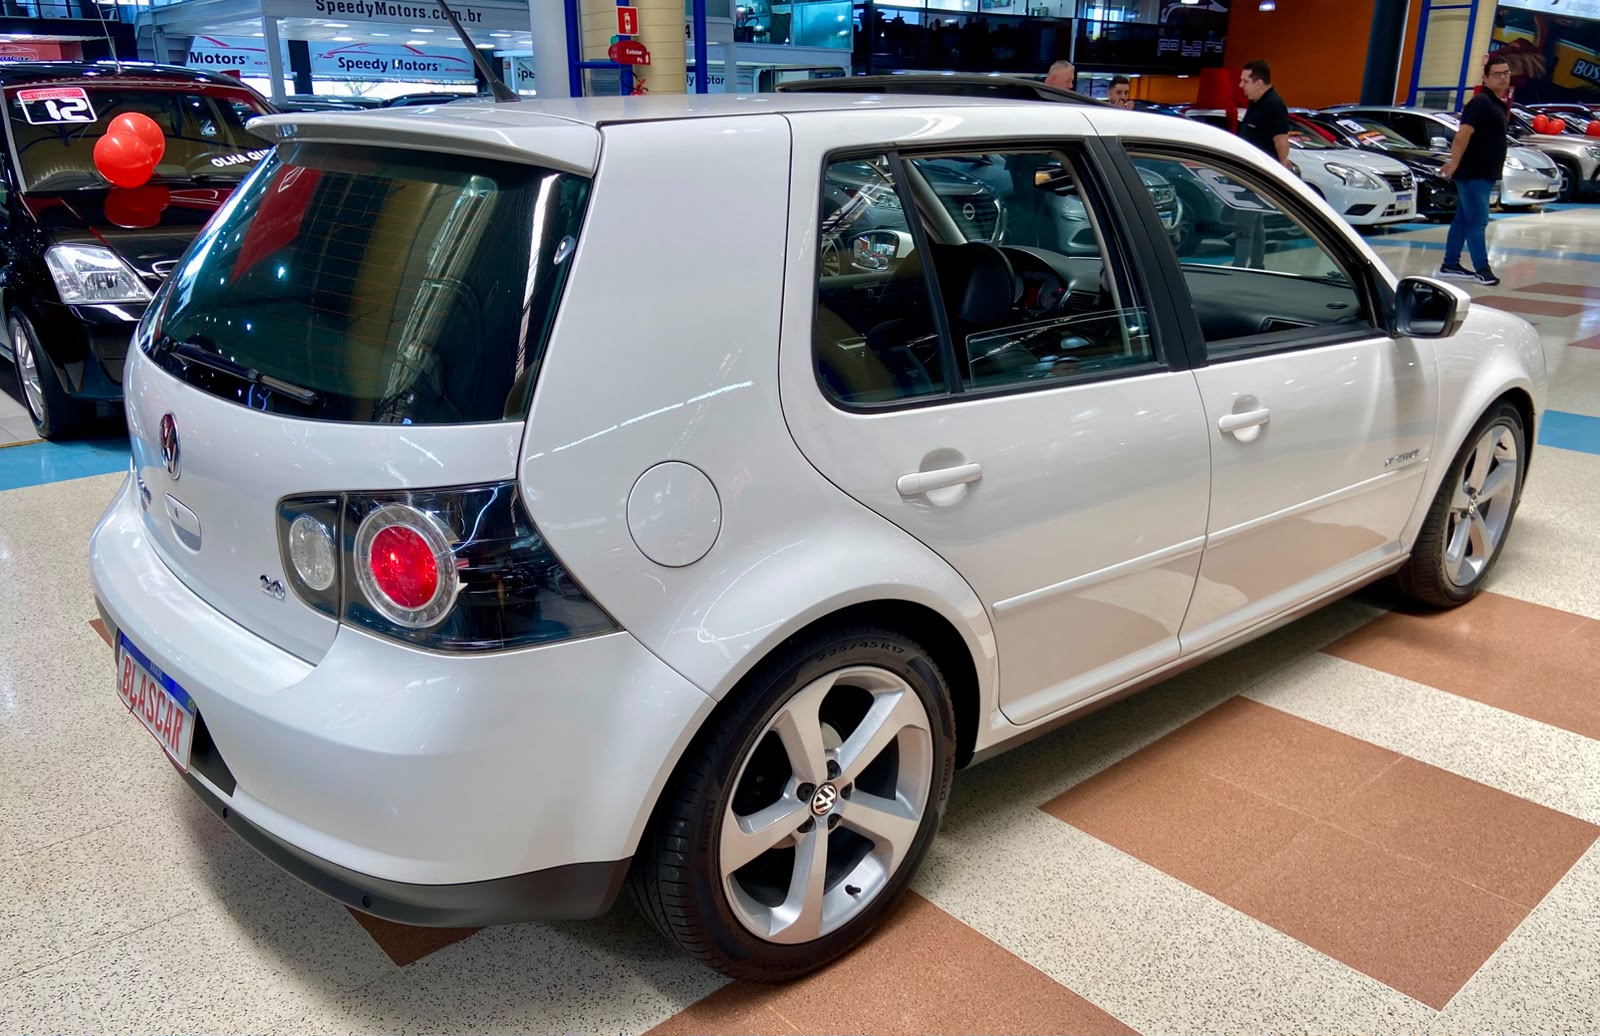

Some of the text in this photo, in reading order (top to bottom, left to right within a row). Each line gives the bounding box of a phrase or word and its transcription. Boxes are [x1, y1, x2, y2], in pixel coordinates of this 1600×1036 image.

[316, 0, 482, 22] SpeedyMotors.com.br
[190, 52, 246, 65] Motors
[338, 57, 438, 73] Speedy Motors
[211, 154, 250, 167] OLHA
[122, 655, 184, 755] BLASCAR
